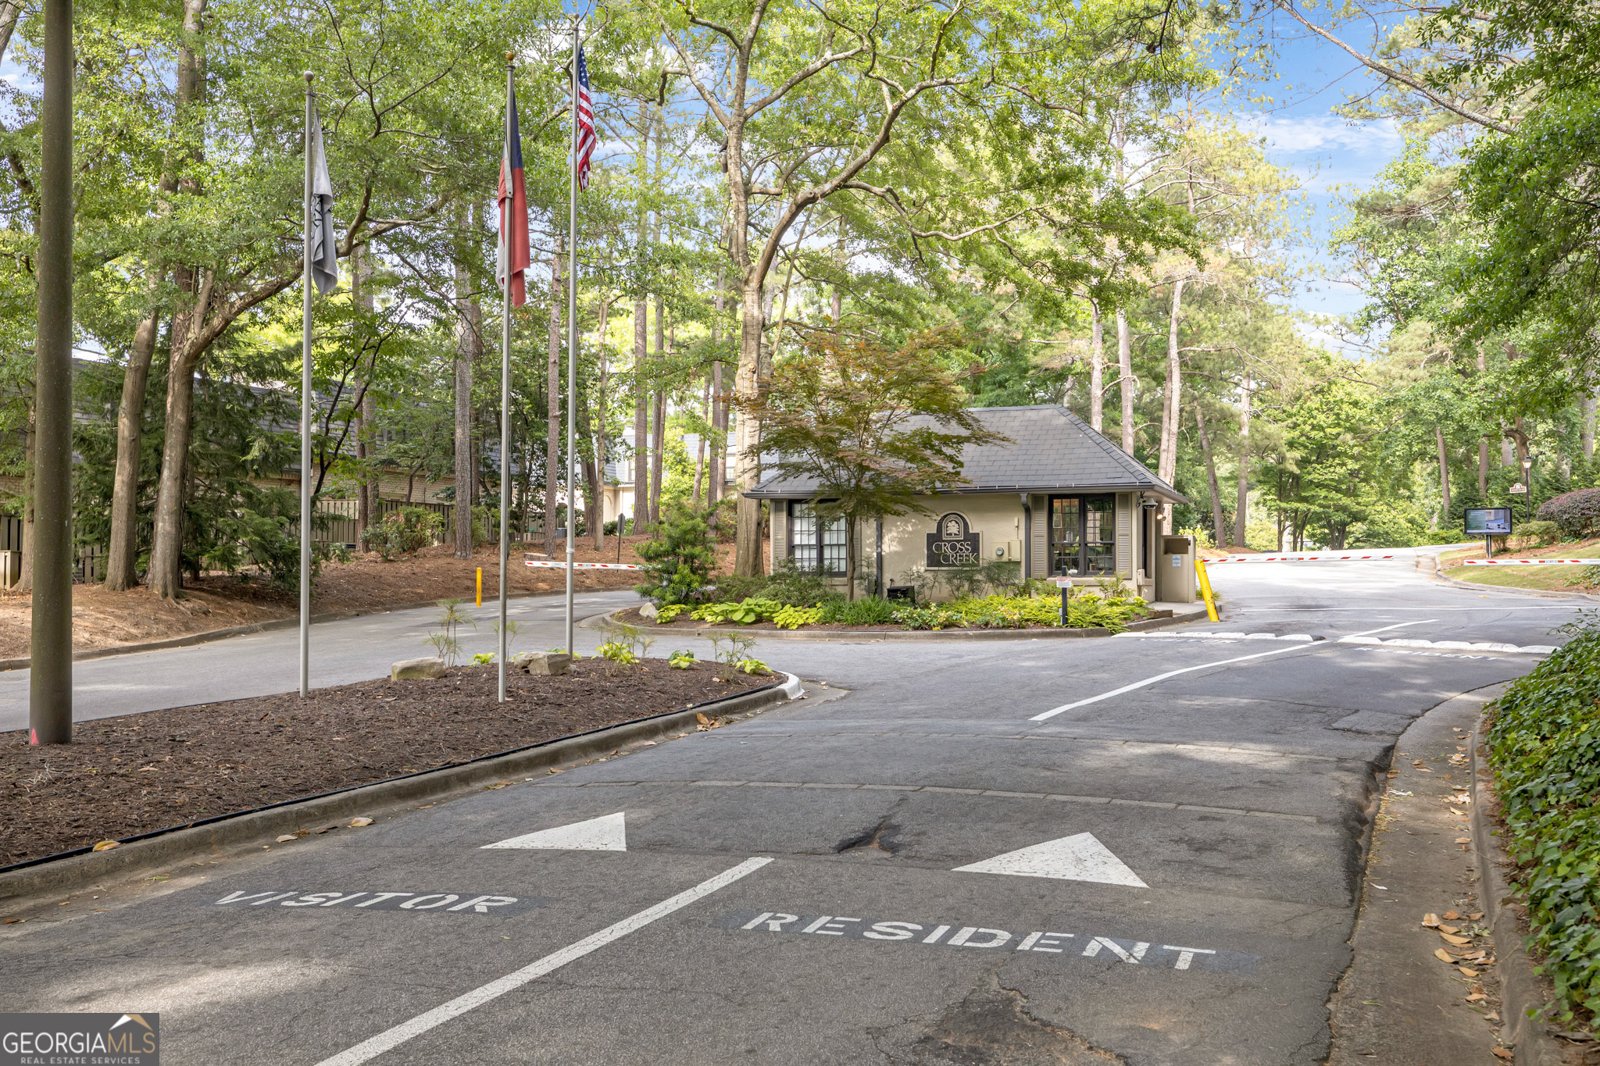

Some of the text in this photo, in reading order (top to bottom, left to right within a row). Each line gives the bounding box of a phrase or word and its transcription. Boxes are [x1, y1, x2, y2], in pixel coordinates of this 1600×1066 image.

[932, 541, 971, 555] CROSS
[940, 552, 978, 566] CREEK
[213, 890, 519, 913] VISITOR
[741, 911, 1217, 970] RESIDENT
